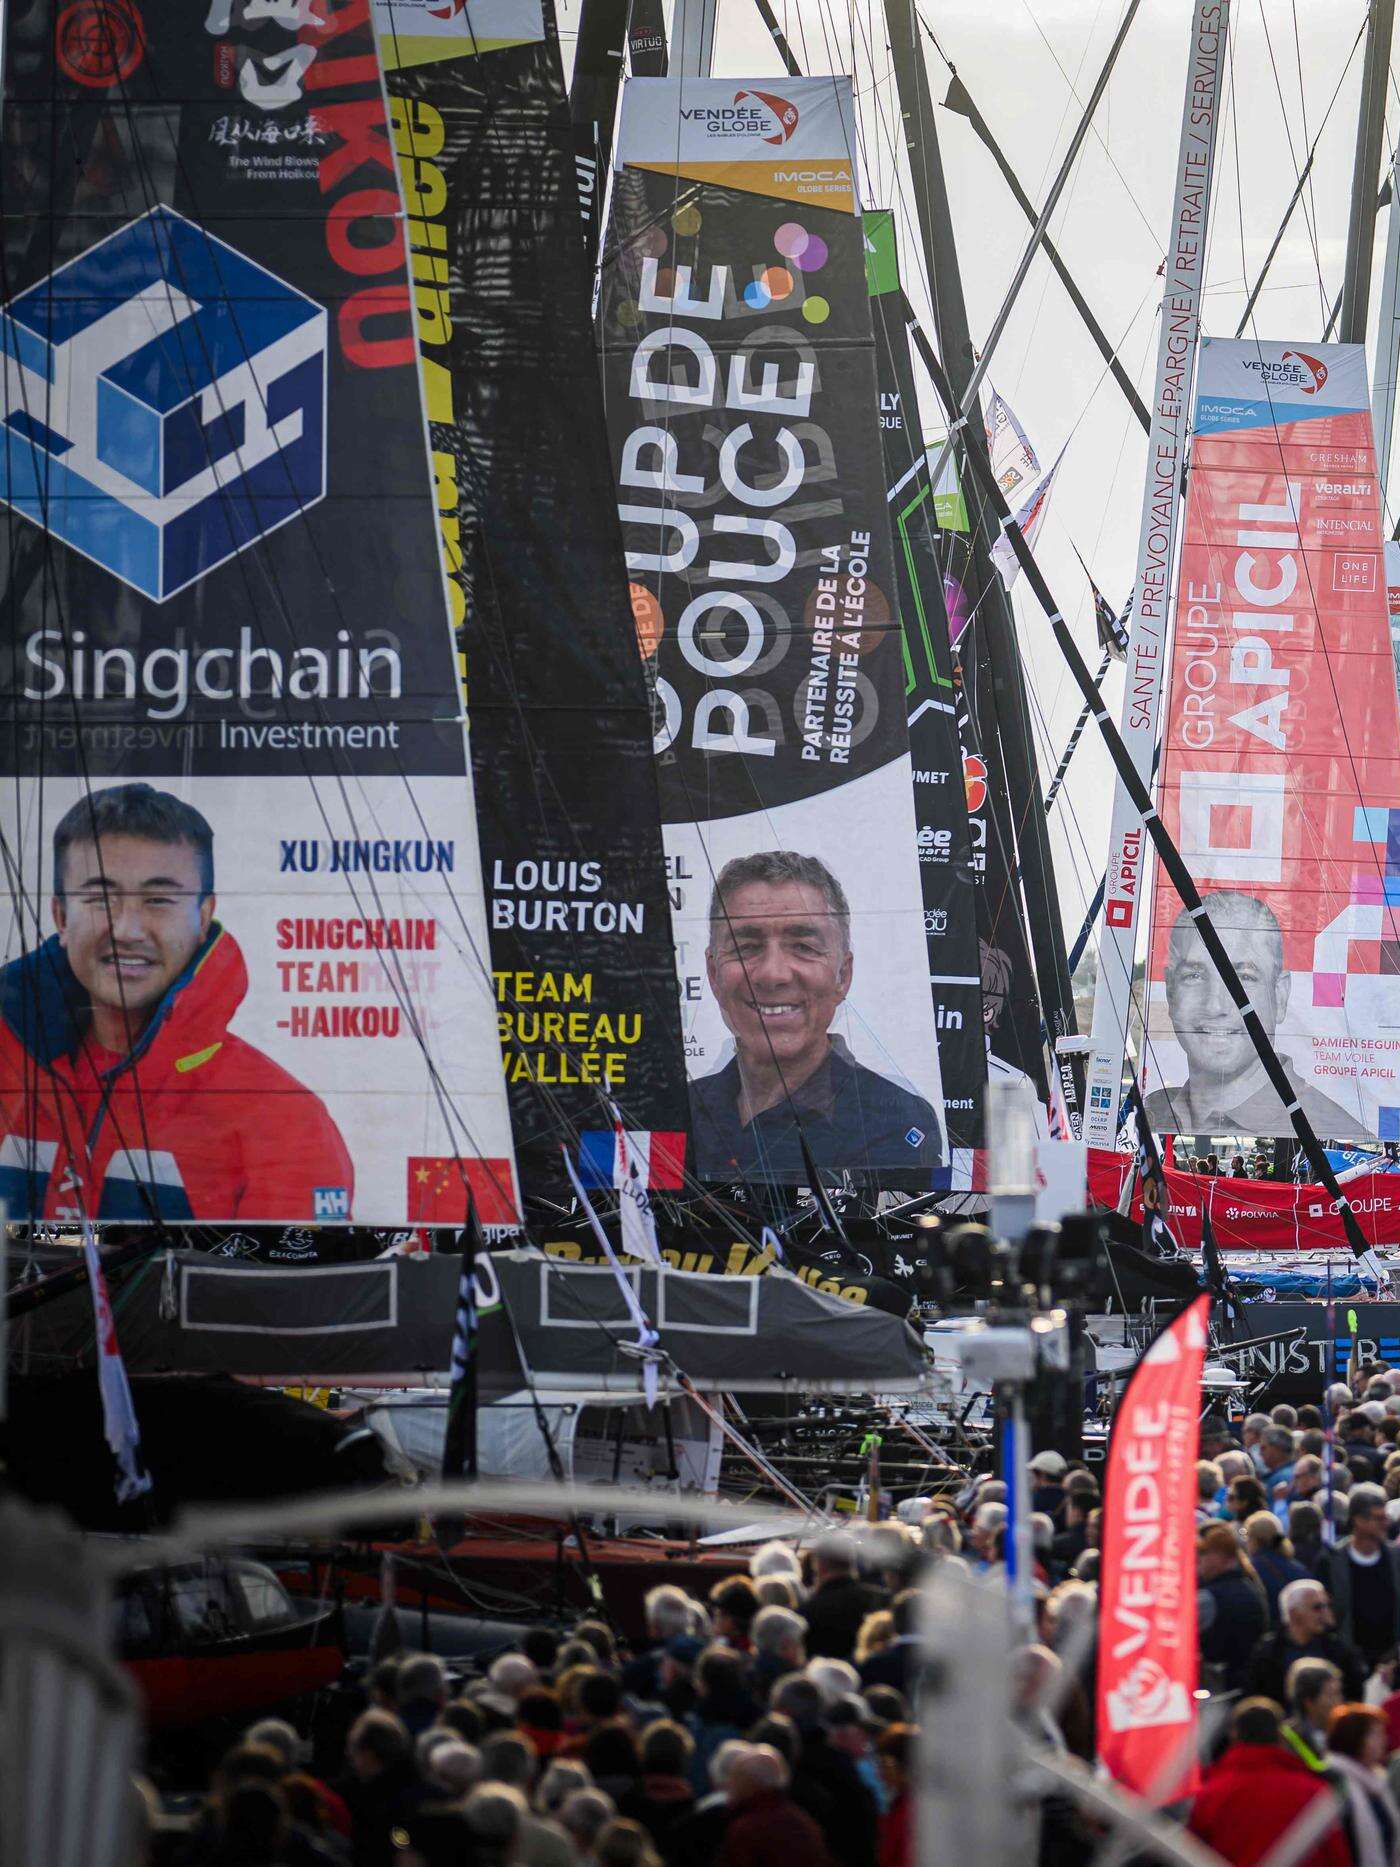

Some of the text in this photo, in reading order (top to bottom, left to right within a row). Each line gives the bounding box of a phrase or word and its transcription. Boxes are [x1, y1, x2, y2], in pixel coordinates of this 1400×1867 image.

[1190, 5, 1223, 127] SERVICES
[680, 106, 763, 121] VENDÉE
[707, 120, 772, 132] GLOBE
[229, 154, 320, 168] The Wind Blows
[245, 166, 277, 180] From
[773, 171, 851, 182] IMOCA
[797, 184, 824, 193] GLOBE
[1176, 151, 1209, 271] RETRAITE
[628, 256, 728, 407] DE
[1159, 297, 1193, 419] ÉPARGNE
[1242, 360, 1303, 374] VENDÉE
[1260, 371, 1308, 383] GLOBE
[1201, 404, 1258, 417] IMOCA
[1310, 452, 1368, 465] GRESHAM
[1141, 441, 1179, 619] PRÉVOYANCE
[1316, 519, 1374, 531] INTENCIAL
[676, 354, 816, 758] POUCE
[1341, 561, 1369, 571] ONE
[1341, 573, 1368, 584] LIFE
[1226, 482, 1302, 752] APICIL
[801, 545, 841, 762] PARTENAIRE DE LA
[1182, 581, 1221, 749] GROUPE
[24, 626, 401, 720] Singchain
[1130, 643, 1158, 731] SANTÉ
[828, 652, 860, 764] RÉUSSITE
[220, 719, 400, 750] Investment
[280, 840, 455, 873] XU JINGKUN
[1109, 851, 1121, 895] GROUPE
[1120, 827, 1142, 896] APICIL
[493, 859, 602, 893] LOUIS
[493, 899, 645, 934] BURTON
[275, 917, 436, 950] SINGCHAIN
[276, 960, 360, 993] TEAM
[492, 971, 593, 1004] TEAM
[496, 1012, 642, 1043] BUREAU
[1311, 1036, 1360, 1050] DAMIEN
[1313, 1050, 1376, 1064] TEAM VOILE
[1313, 1065, 1397, 1079] GROUPE APICIL
[1328, 1197, 1392, 1216] GOUPE
[1111, 1398, 1171, 1660] VENDÉE
